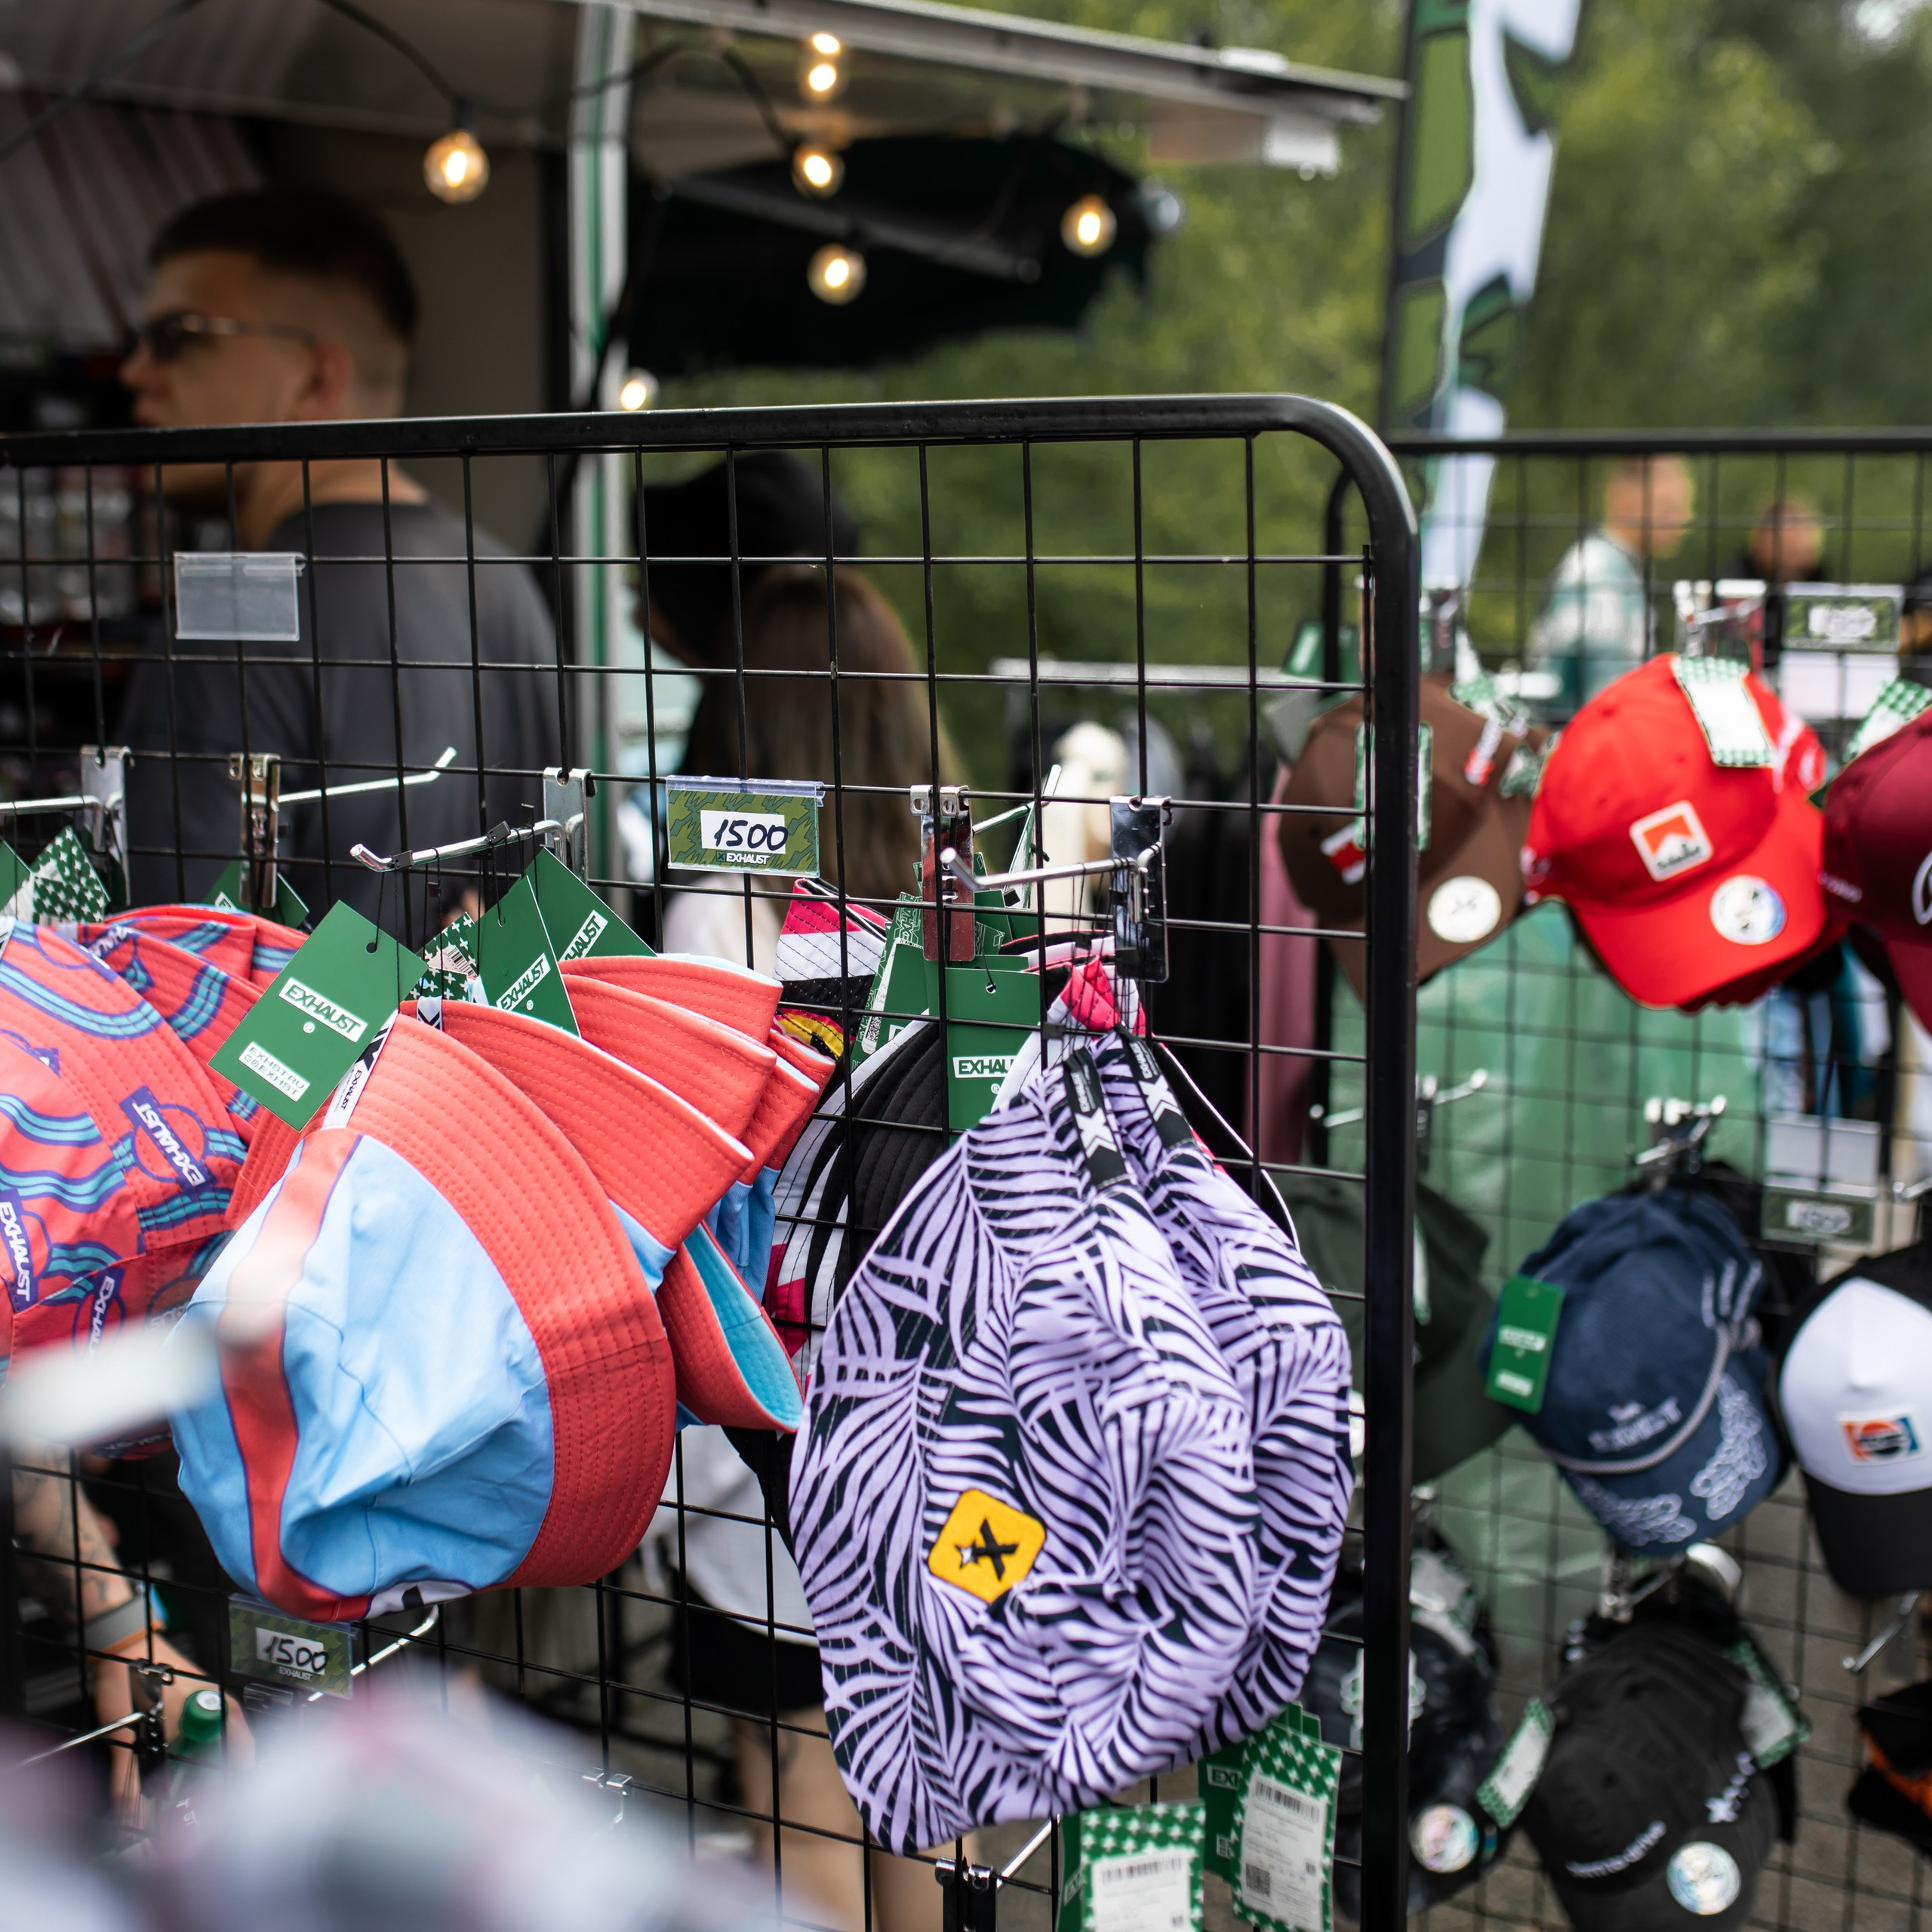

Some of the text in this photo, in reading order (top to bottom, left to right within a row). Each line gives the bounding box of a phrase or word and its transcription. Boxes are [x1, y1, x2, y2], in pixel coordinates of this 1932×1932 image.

[714, 819, 789, 851] 1500
[726, 852, 769, 864] EXHAUST
[565, 915, 601, 960] HAUST
[500, 957, 544, 1010] EXHAUST
[285, 983, 361, 1034] EXHAUST
[958, 1059, 1014, 1075] EXHAU
[340, 1069, 363, 1111] EXHAUST
[132, 1103, 206, 1186] EXHAUST
[0, 1201, 31, 1302] EXHAUST
[88, 1275, 115, 1357] EXHAU
[263, 1635, 329, 1672] 1500
[278, 1666, 313, 1681] EXHAUST
